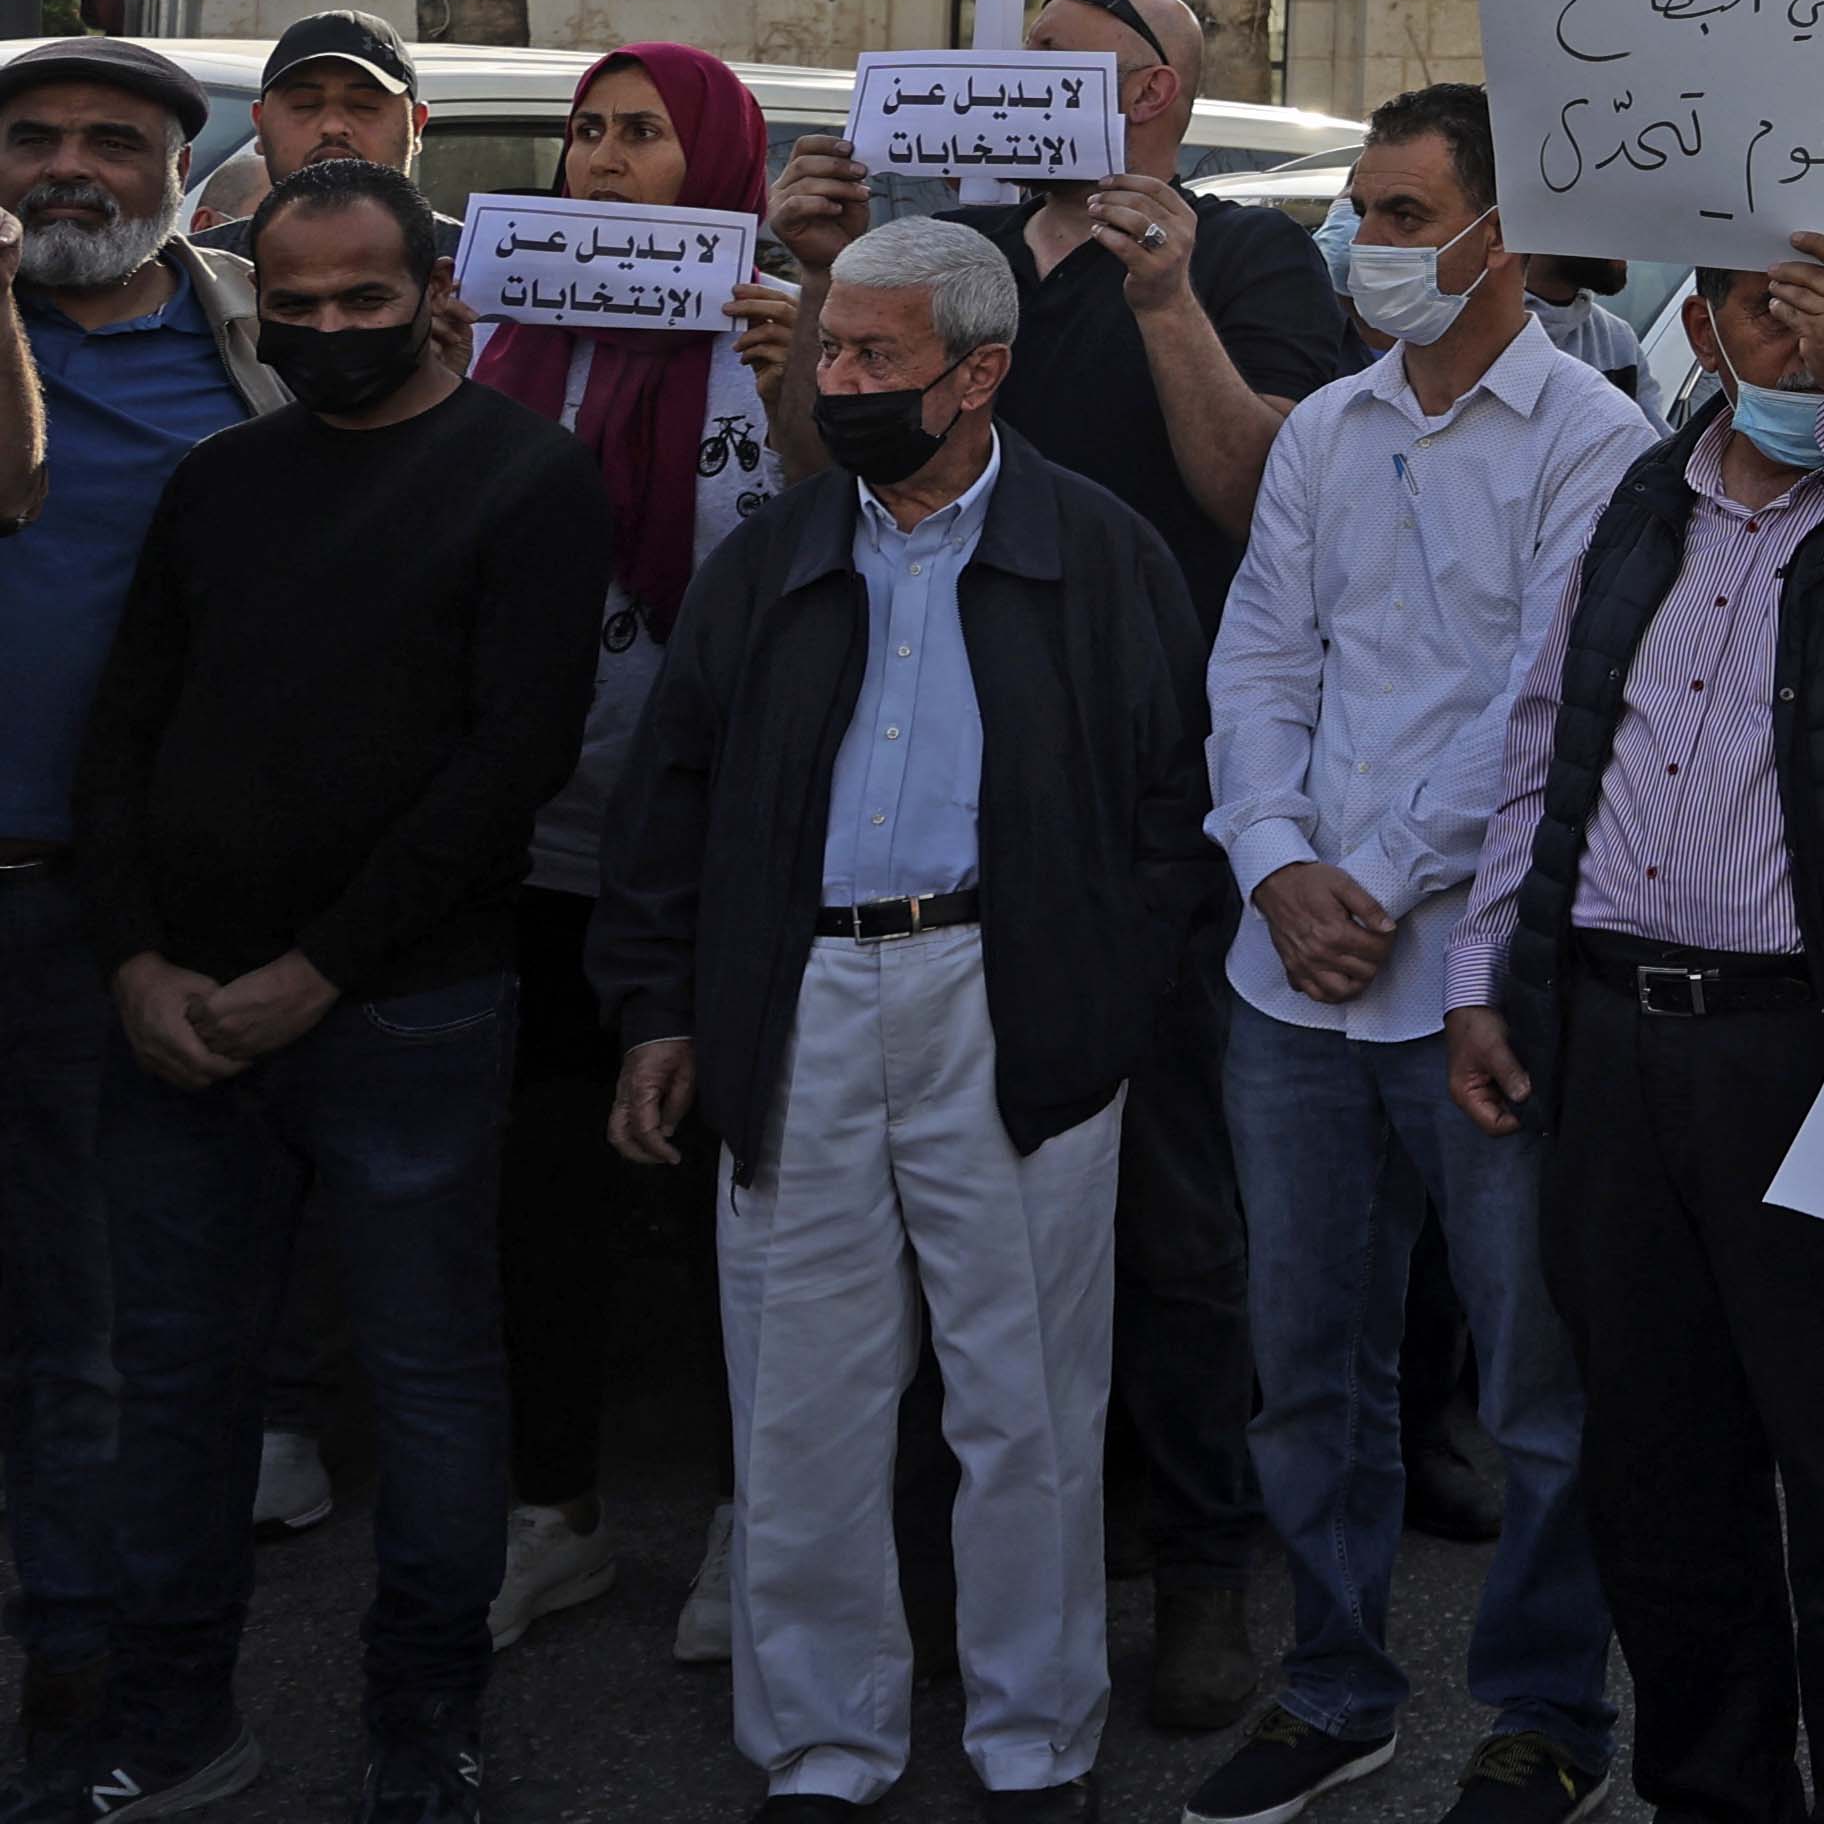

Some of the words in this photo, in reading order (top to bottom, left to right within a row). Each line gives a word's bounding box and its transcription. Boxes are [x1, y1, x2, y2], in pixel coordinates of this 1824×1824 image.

[881, 74, 946, 116] عن
[952, 75, 1055, 122] بديل
[1060, 77, 1084, 110] لا
[887, 131, 1078, 175] الإنتخابات
[494, 221, 568, 260] عن
[575, 224, 688, 274] بديل
[695, 231, 722, 265] لا
[499, 276, 704, 322] الإنتخابات
